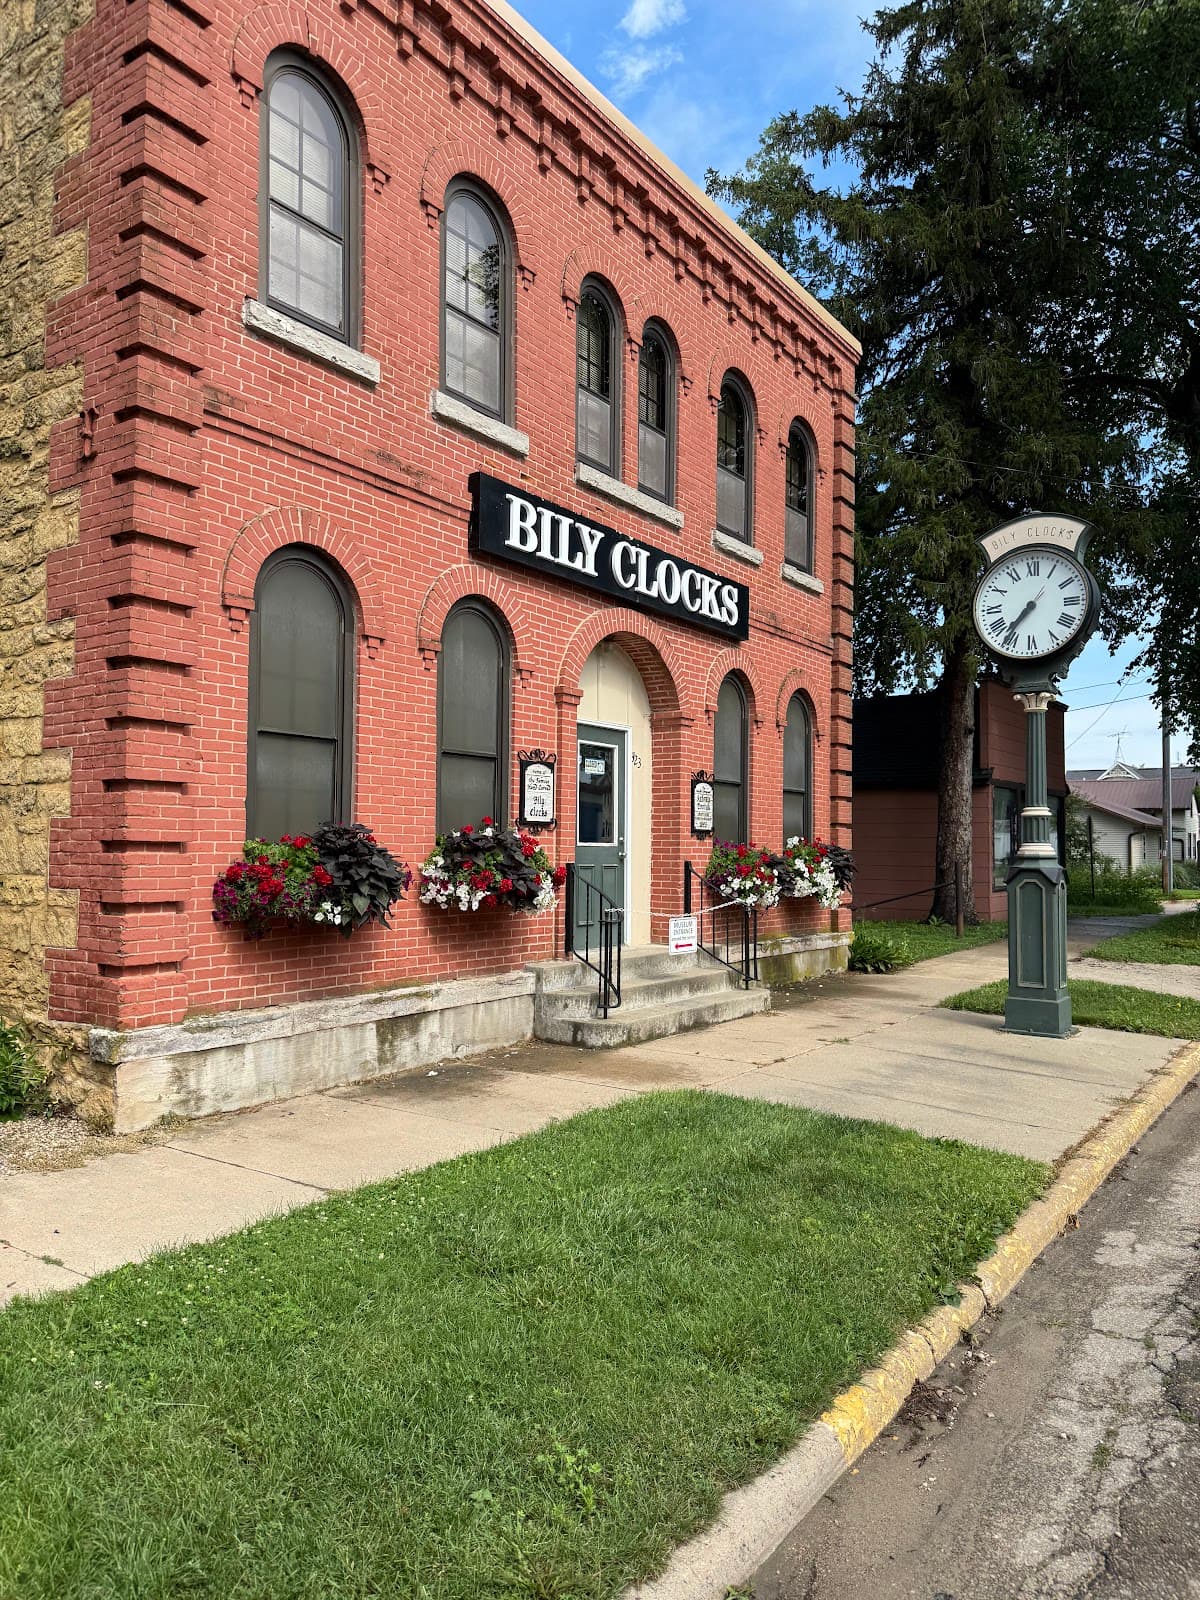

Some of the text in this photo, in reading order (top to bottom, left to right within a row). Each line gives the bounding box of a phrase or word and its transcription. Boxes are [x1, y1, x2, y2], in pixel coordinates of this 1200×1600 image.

[991, 526, 1074, 550] BILY CLOCKS
[505, 493, 739, 626] BILY CLOCKS
[1026, 560, 1040, 577] XII
[1063, 595, 1081, 606] III
[673, 920, 693, 929] MUSEUM
[673, 927, 693, 936] ENTRANCE
